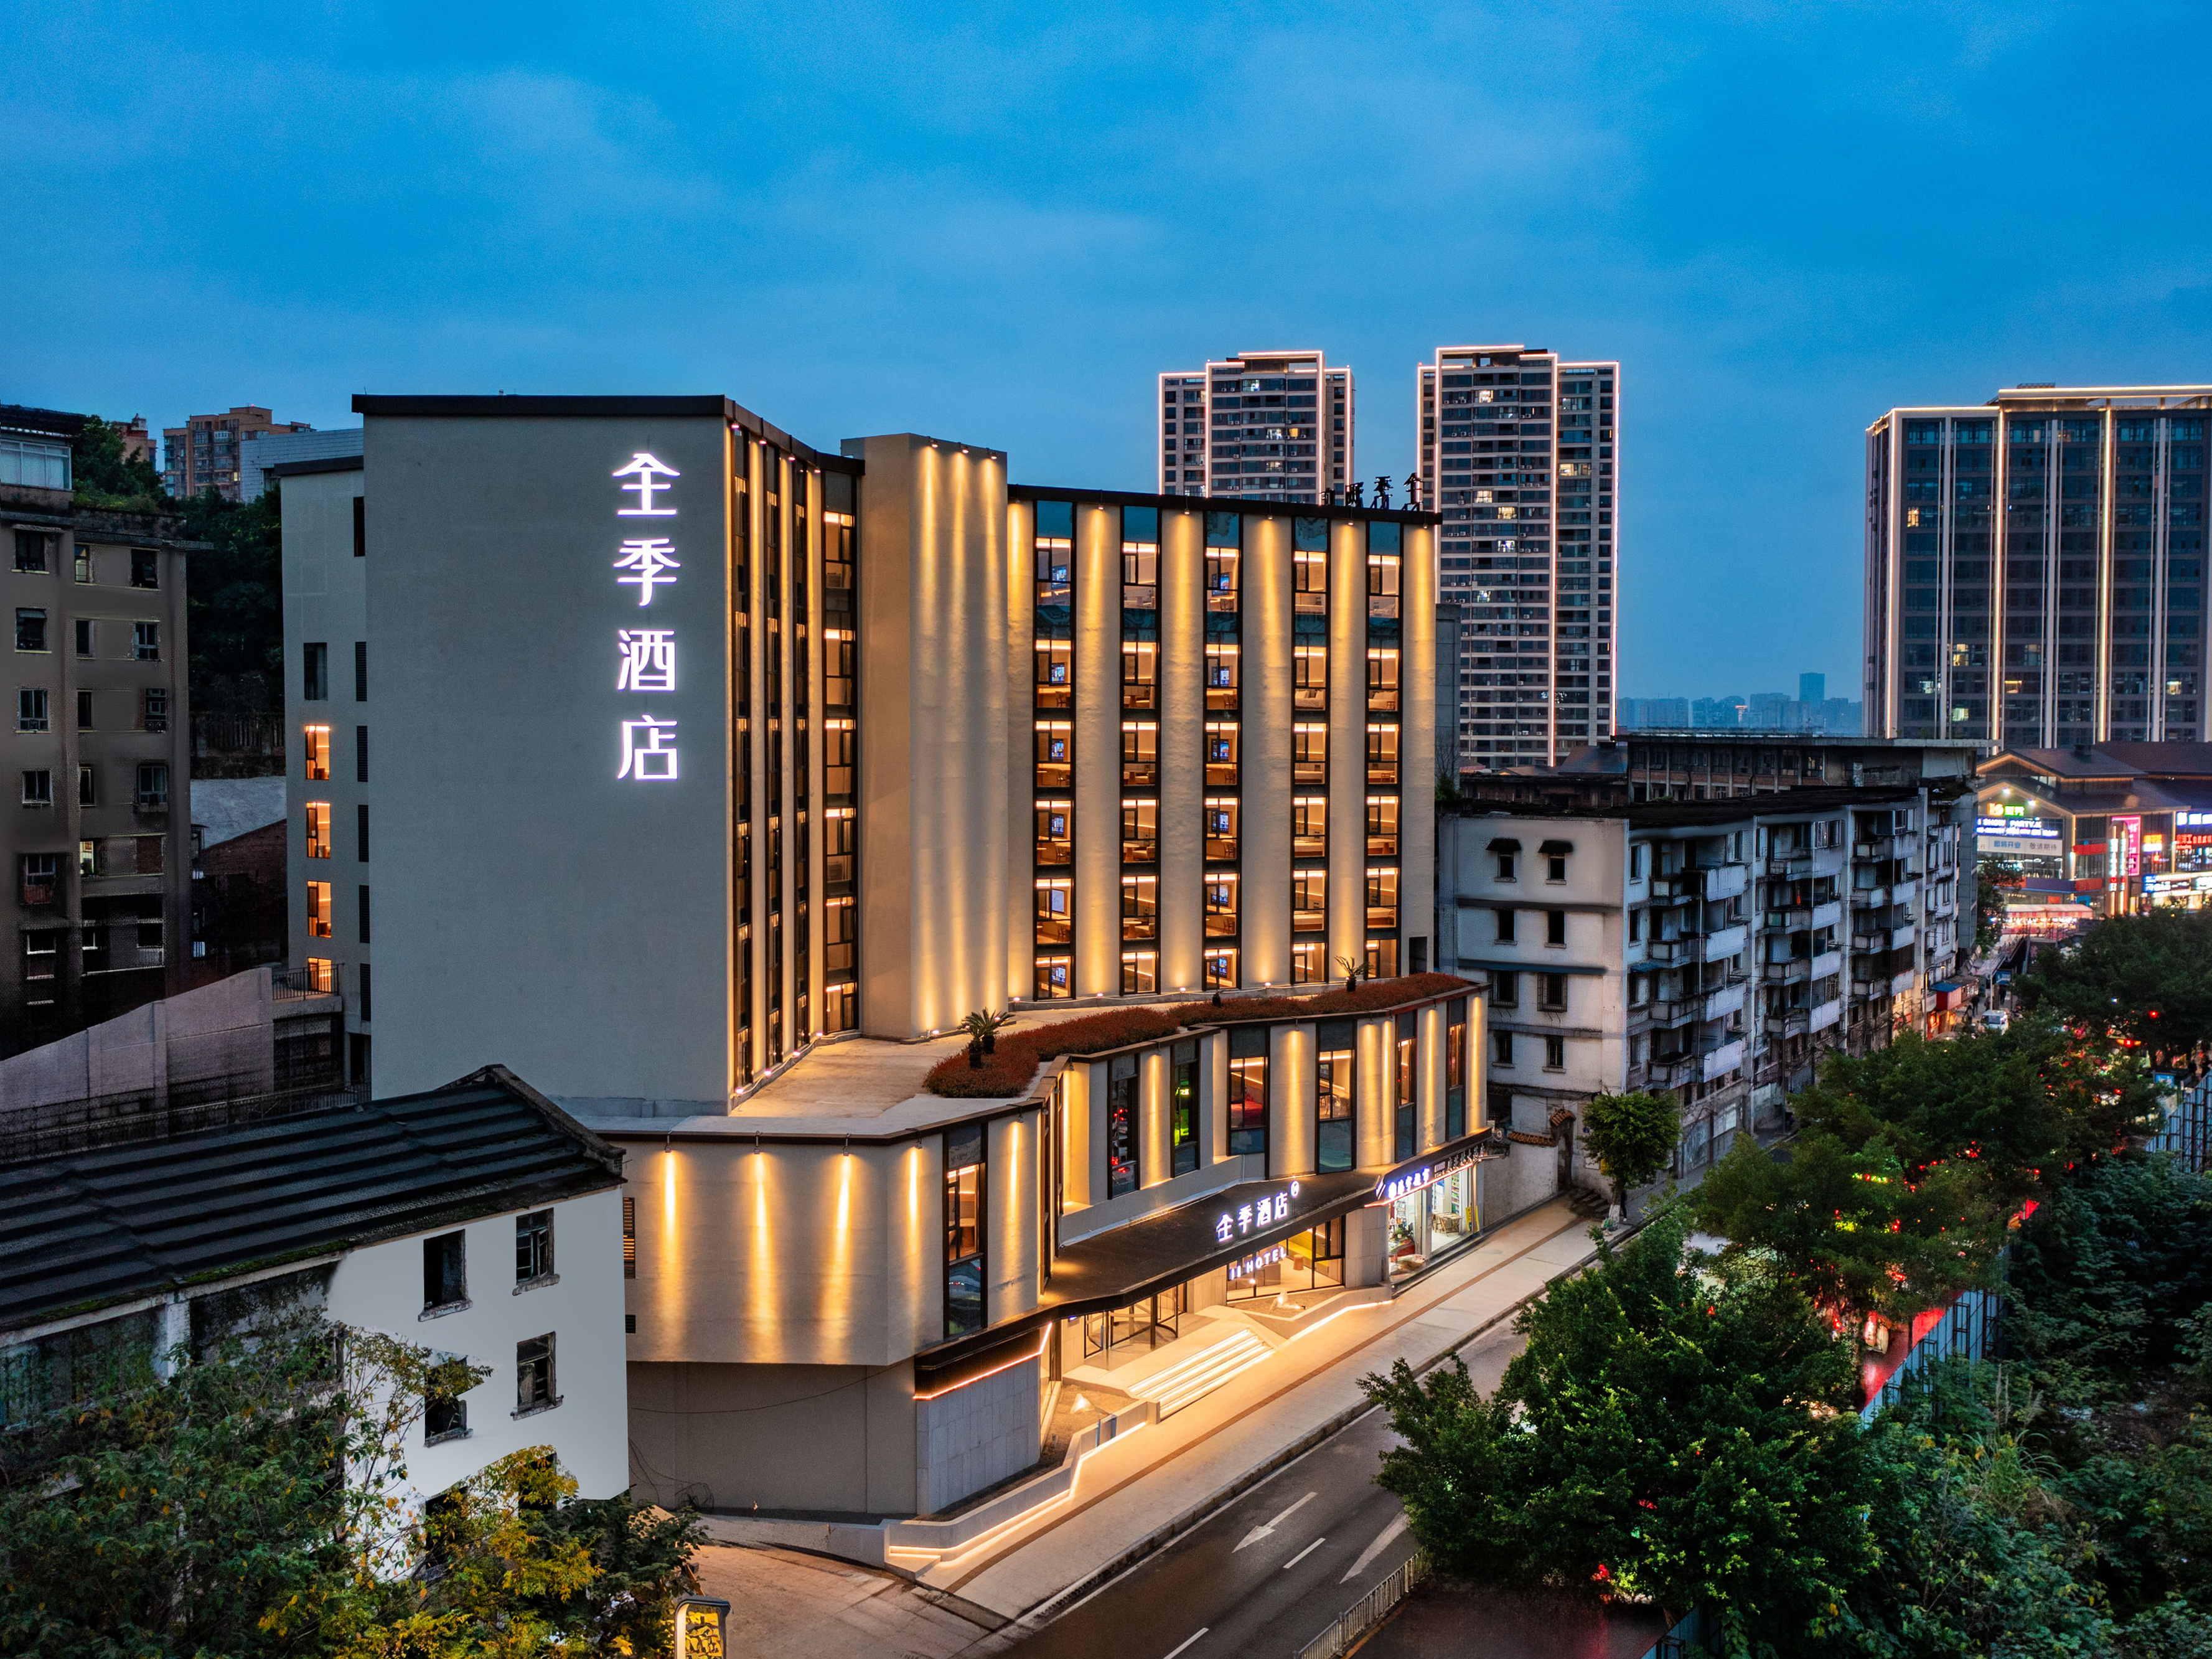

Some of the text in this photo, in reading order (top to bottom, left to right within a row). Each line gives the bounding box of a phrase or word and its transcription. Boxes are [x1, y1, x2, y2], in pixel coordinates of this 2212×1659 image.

[612, 453, 681, 781] 全季酒店
[2030, 842, 2057, 851] 敬请期待
[1216, 1191, 1288, 1242] 全季酒店
[1246, 1246, 1287, 1274] HOTEL
